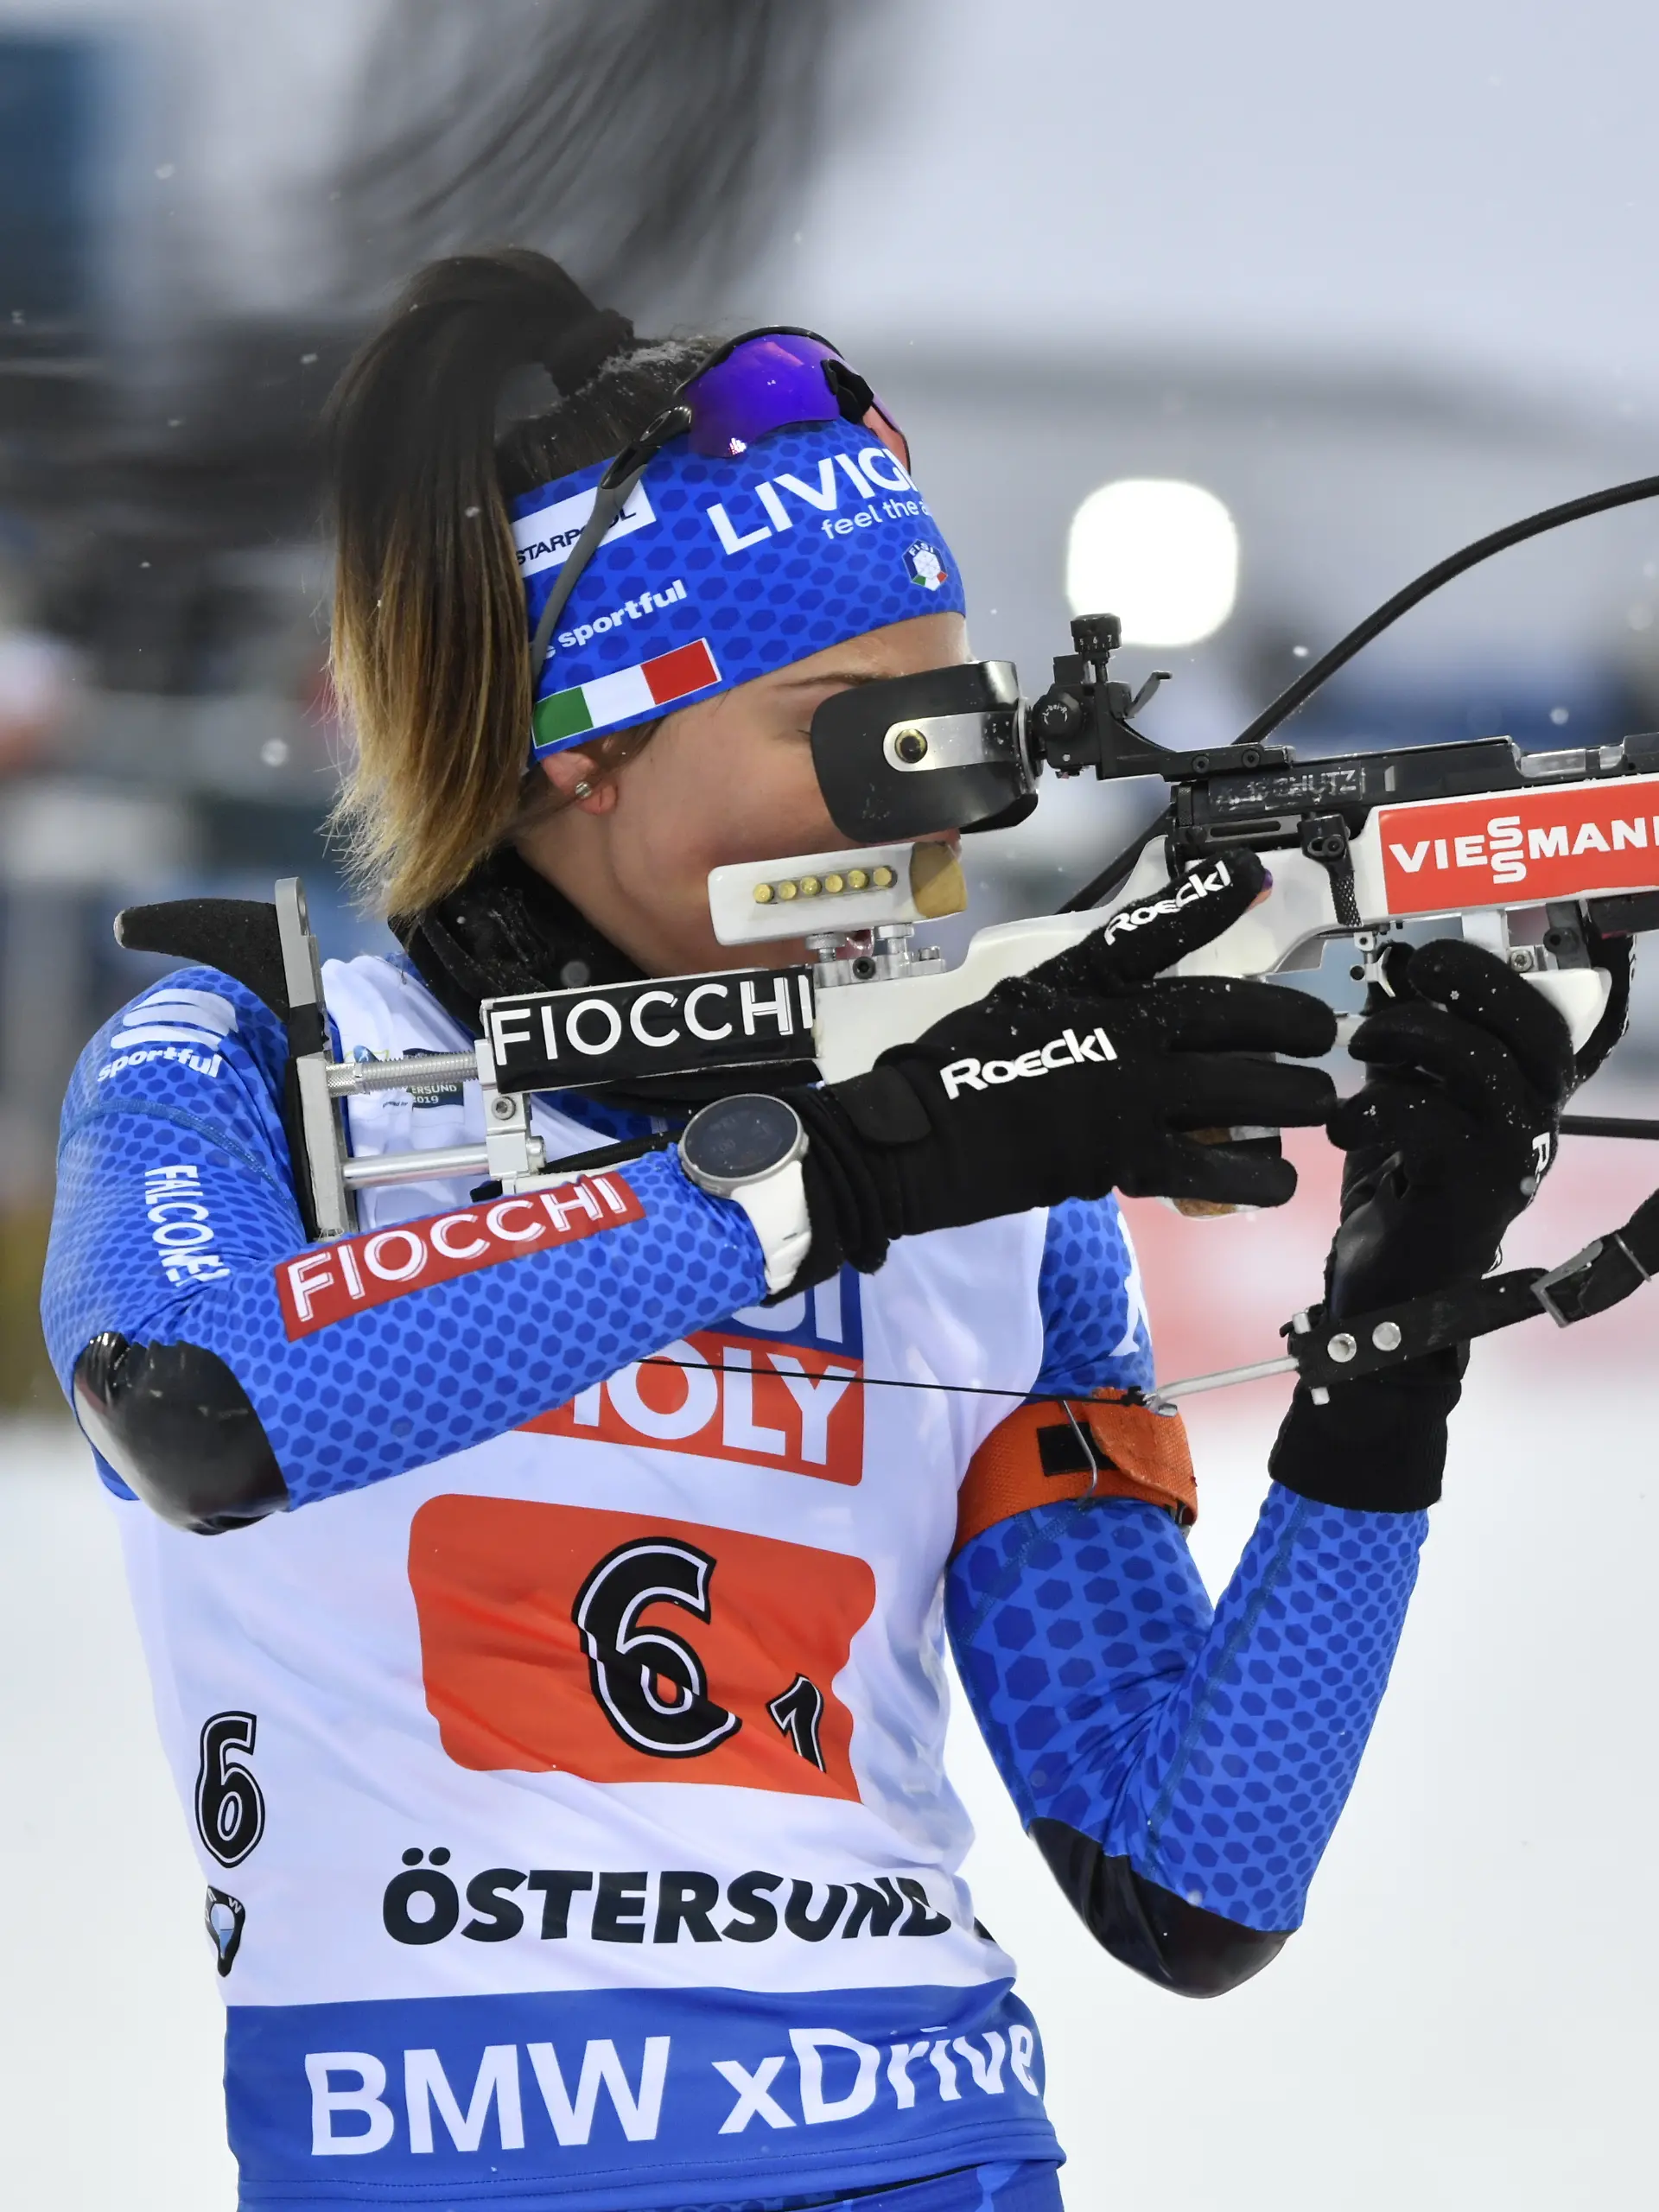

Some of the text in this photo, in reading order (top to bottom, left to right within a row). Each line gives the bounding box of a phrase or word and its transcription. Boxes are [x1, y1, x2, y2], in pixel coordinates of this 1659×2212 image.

[516, 508, 637, 565] STARPL
[822, 504, 883, 539] feel
[882, 499, 919, 519] the
[907, 542, 934, 556] FISI
[557, 579, 688, 648] sportful
[1389, 816, 1659, 885] VIESSMAN
[490, 974, 814, 1066] FIOCCHI
[97, 1047, 222, 1082] sportful
[410, 1084, 457, 1094] ERSUND
[940, 1028, 1117, 1100] Roeckl
[288, 1176, 627, 1322] FIOCCHI
[573, 1338, 858, 1466] OLY
[571, 1535, 742, 1758] 6
[765, 1673, 828, 1774] 1
[194, 1711, 266, 1869] 6
[382, 1847, 952, 1946] ÖSTERSUND
[304, 2024, 1039, 2157] BMW xDrive
